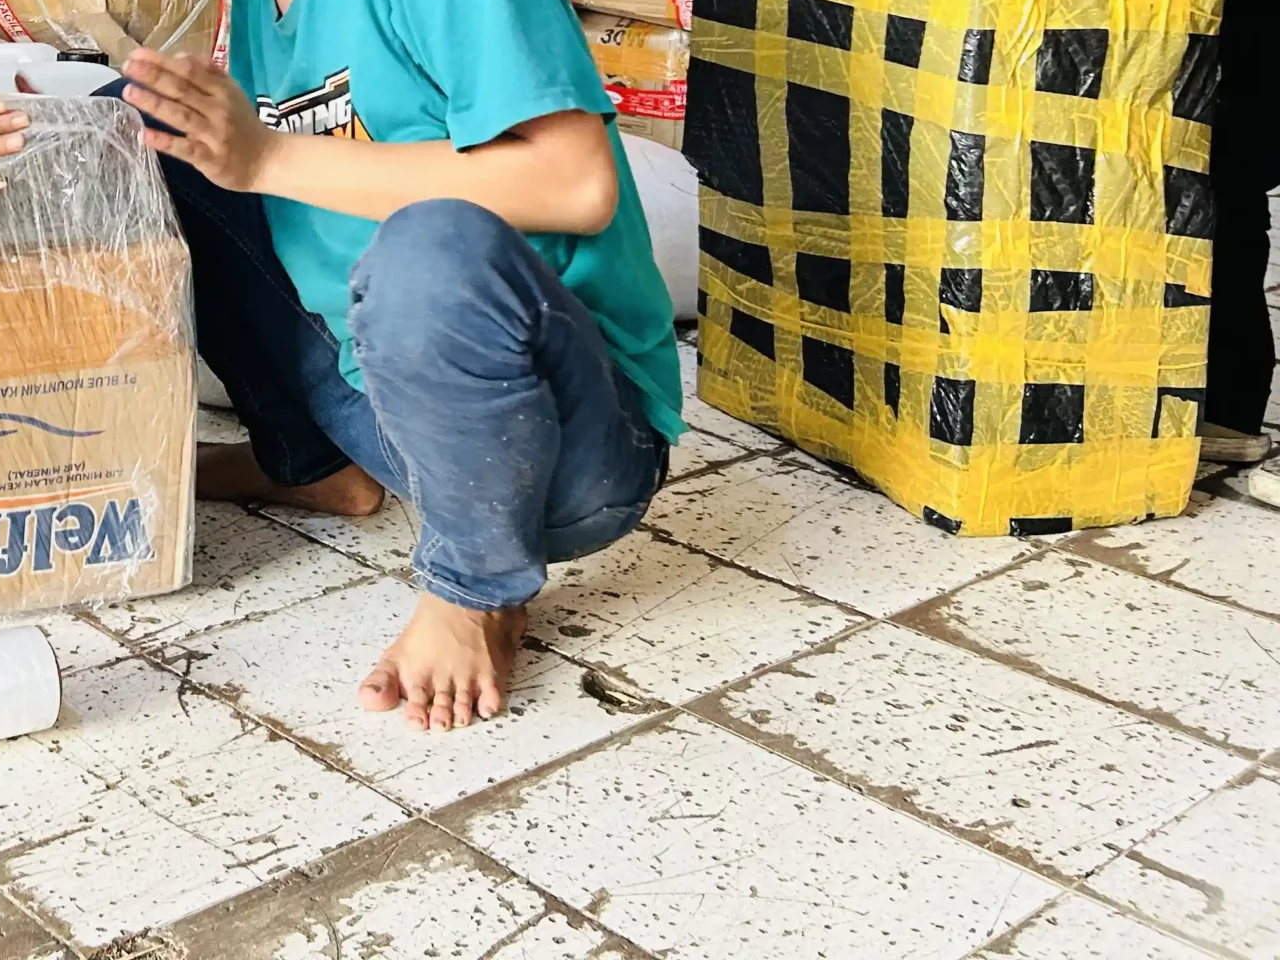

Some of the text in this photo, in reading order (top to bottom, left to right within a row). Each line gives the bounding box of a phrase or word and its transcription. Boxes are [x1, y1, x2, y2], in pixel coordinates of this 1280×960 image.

[87, 375, 119, 390] BLUE
[120, 372, 138, 386] PT
[21, 377, 85, 396] MOUNTAIN
[7, 461, 87, 481] (AIR MINERAL)
[65, 470, 103, 483] MINUM
[105, 468, 124, 479] AIR
[23, 474, 63, 488] DALAM
